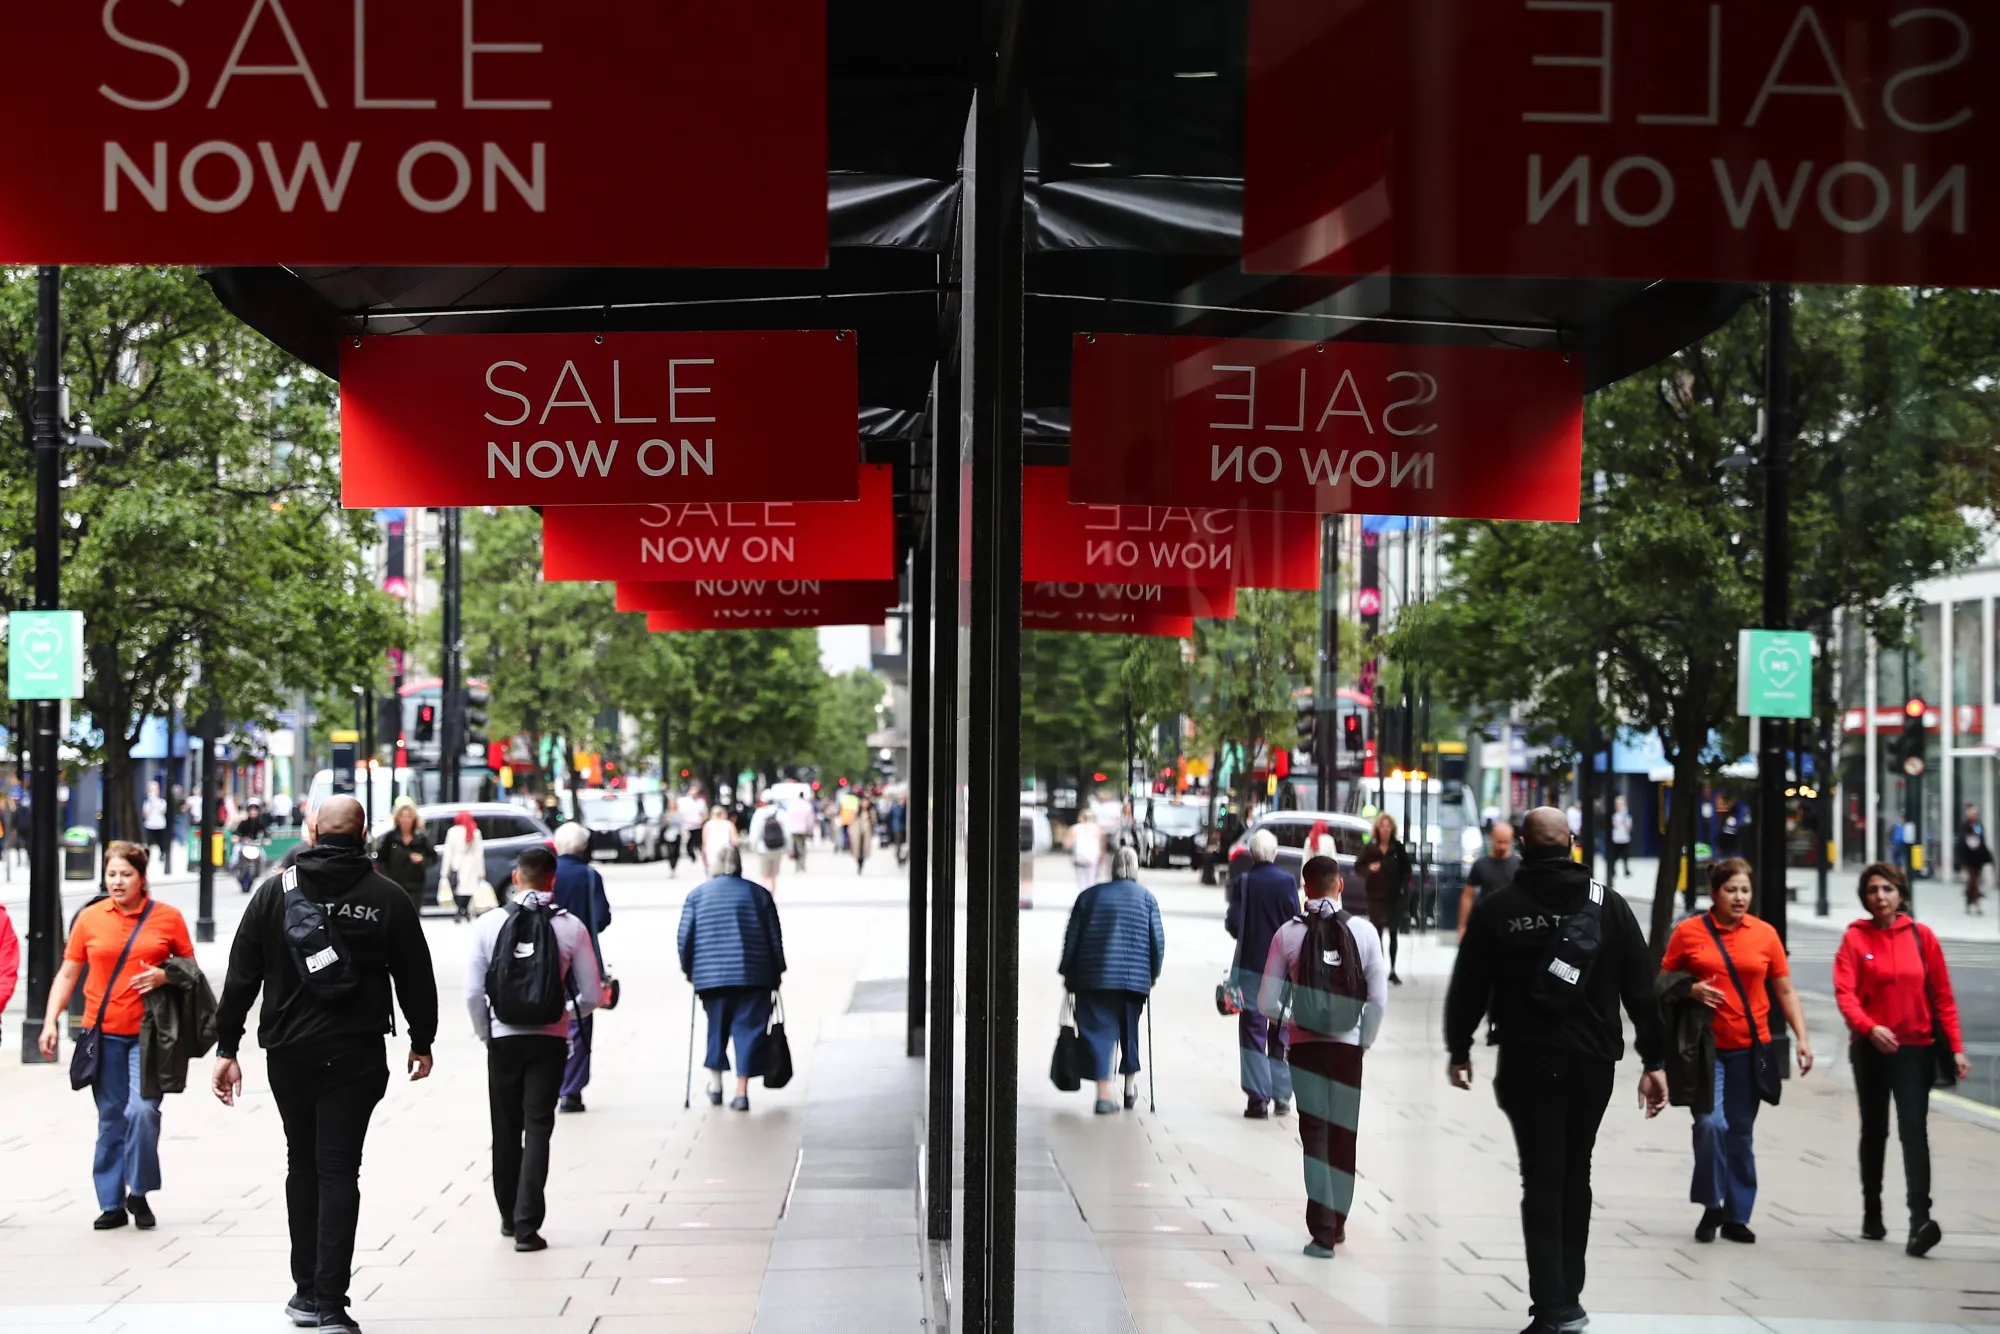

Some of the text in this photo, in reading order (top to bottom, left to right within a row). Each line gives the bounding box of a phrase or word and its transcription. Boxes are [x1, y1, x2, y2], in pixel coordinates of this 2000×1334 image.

[98, 0, 552, 110] SALE
[104, 141, 546, 213] NOW ON
[484, 358, 716, 426] SALE
[487, 438, 714, 479] NOW ON
[641, 536, 795, 563] NOW ON
[695, 580, 821, 597] NOW ON
[337, 903, 380, 922] ASK
